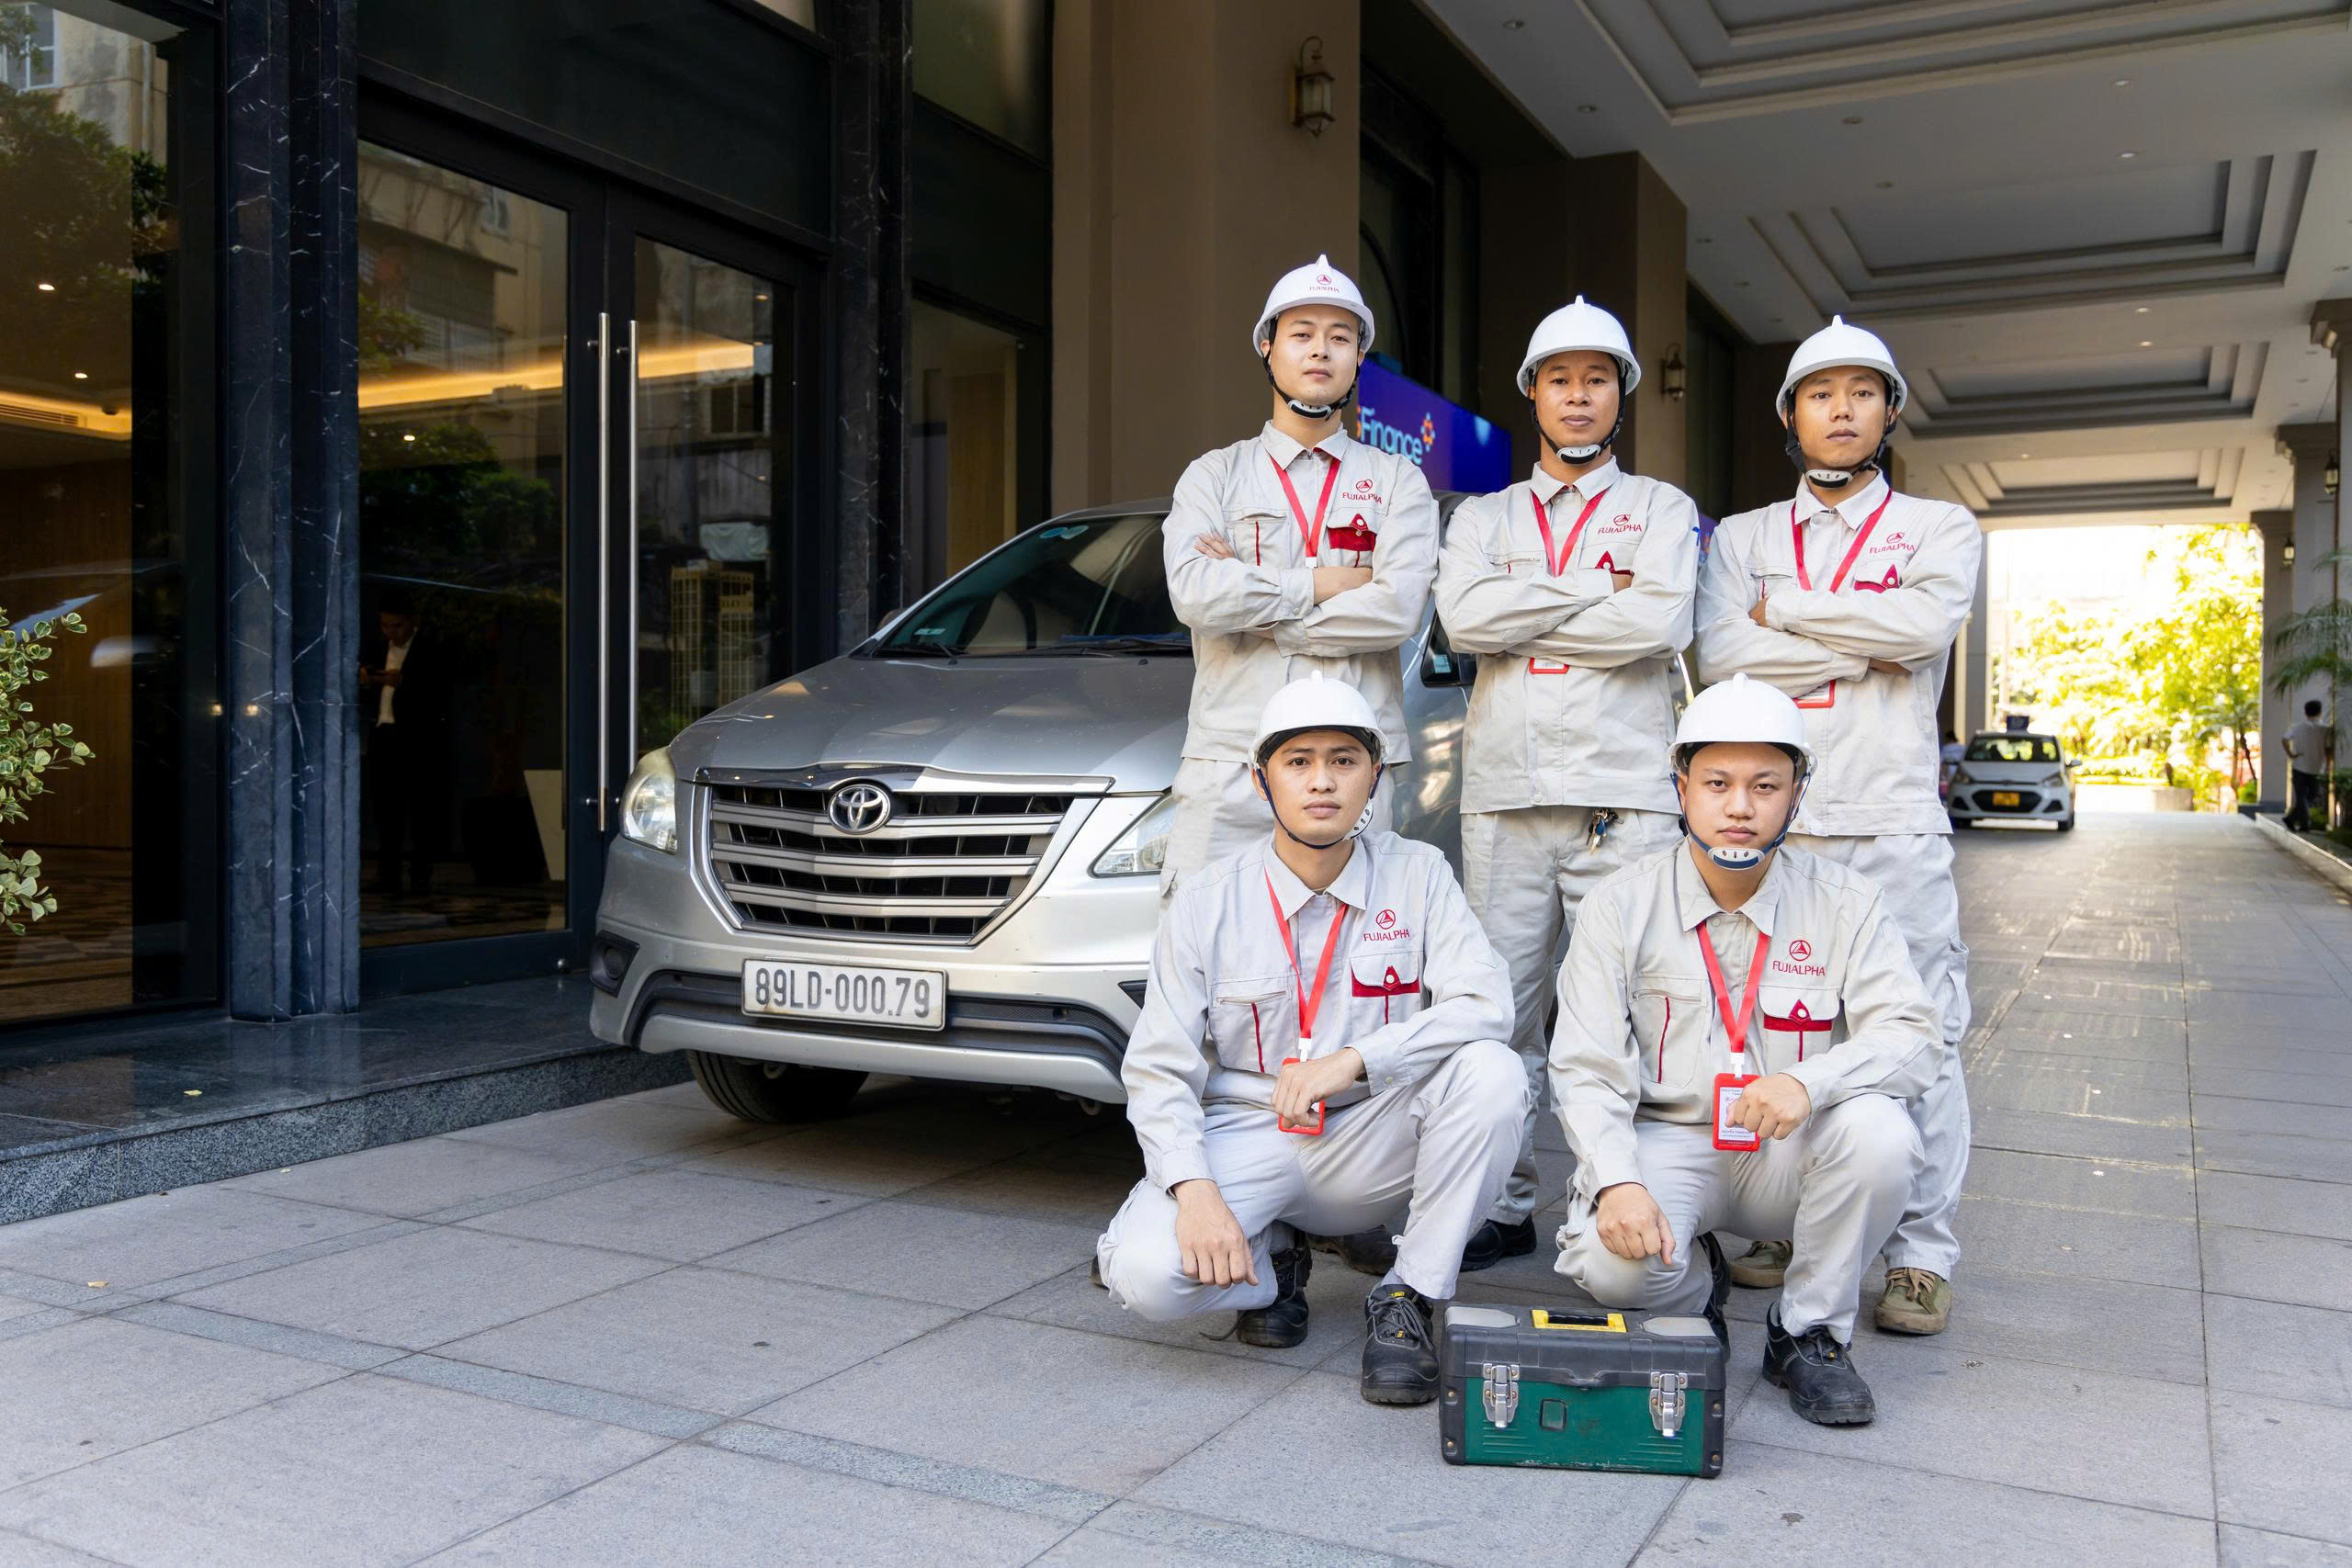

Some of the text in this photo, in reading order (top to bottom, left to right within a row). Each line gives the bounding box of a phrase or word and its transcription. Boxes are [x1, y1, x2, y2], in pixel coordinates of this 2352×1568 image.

[1357, 404, 1422, 465] Finance
[1342, 491, 1382, 504] FUJIALPHA
[1598, 524, 1642, 534] FUJIALPHA
[1870, 542, 1916, 554] FUJIALPHA
[1363, 928, 1410, 942] FUJIALPHA
[1772, 960, 1826, 976] FUJIALPHA
[756, 967, 931, 1018] 89LD-000.79
